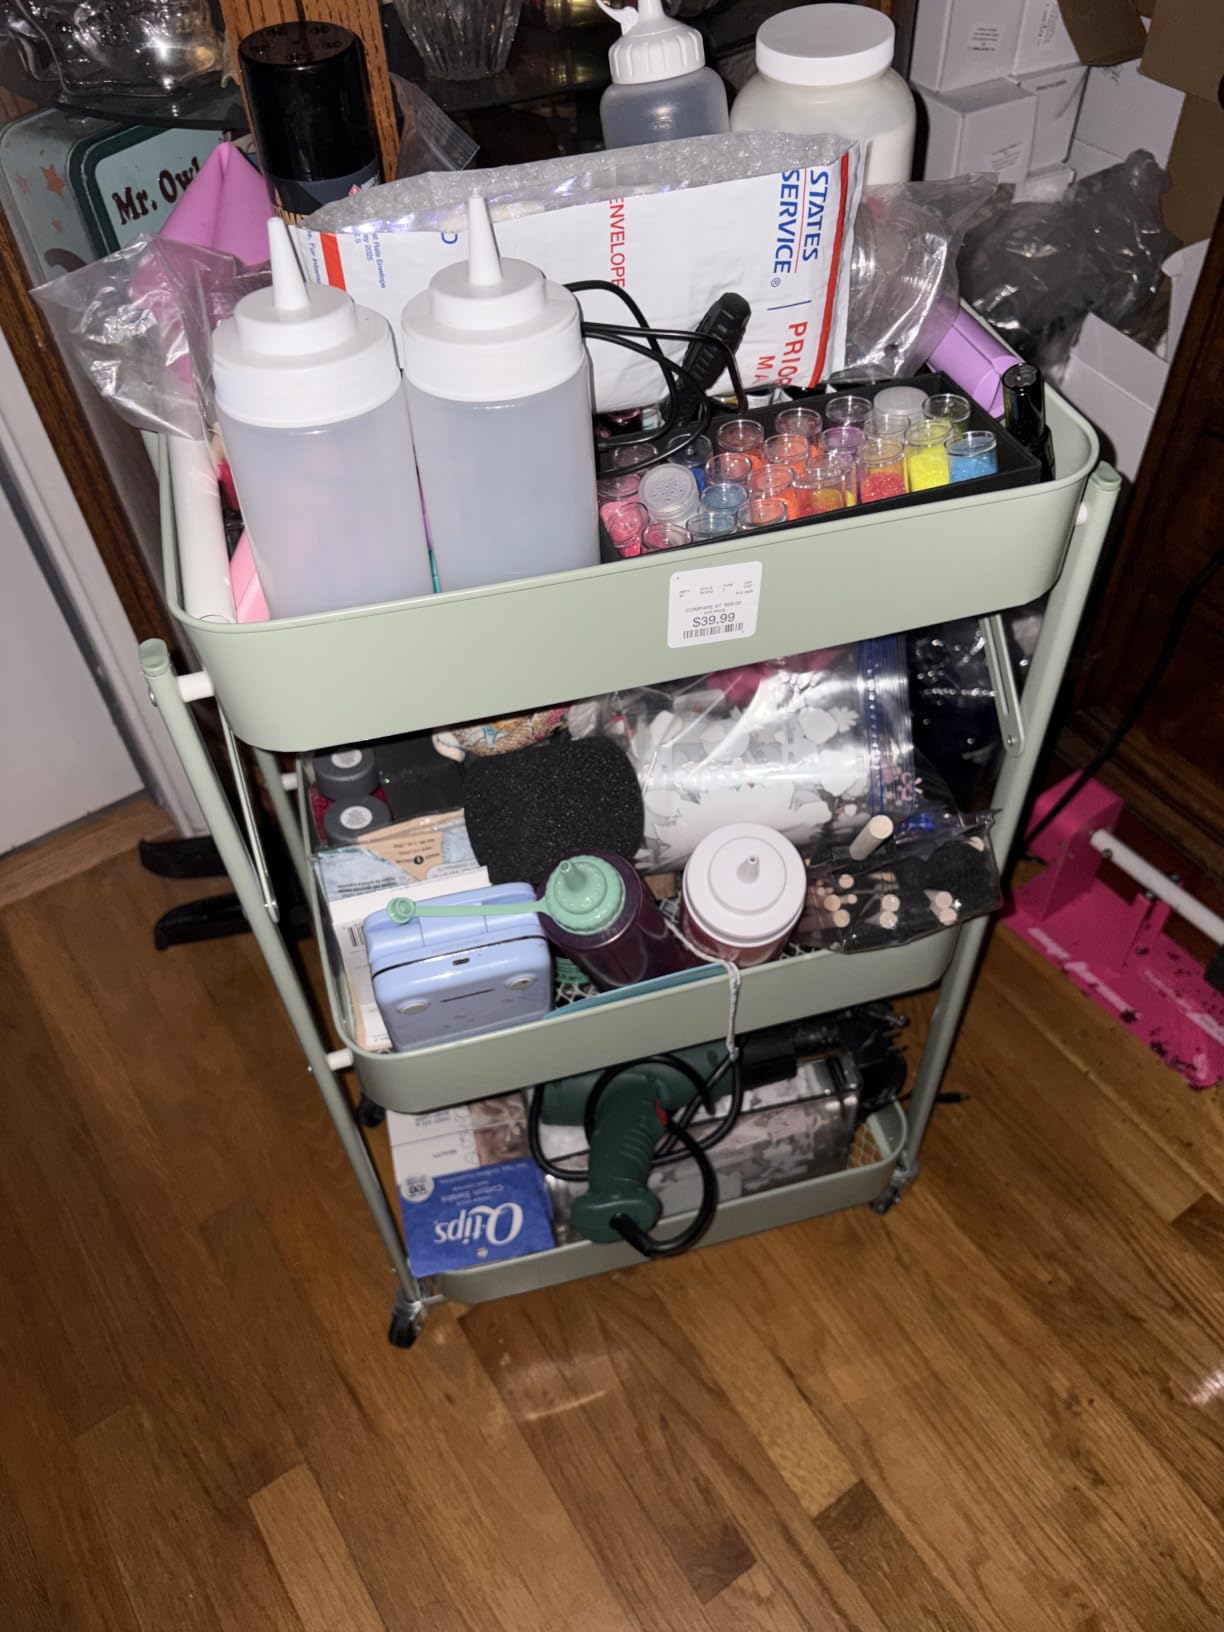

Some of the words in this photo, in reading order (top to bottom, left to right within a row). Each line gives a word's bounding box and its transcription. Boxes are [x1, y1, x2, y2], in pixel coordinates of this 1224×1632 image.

[112, 187, 158, 225] Mr.
[773, 168, 800, 274] SERVICE
[802, 169, 829, 262] STATES
[376, 259, 387, 289] Envelope
[685, 604, 713, 613] COMPARE
[692, 612, 736, 628] $39.99
